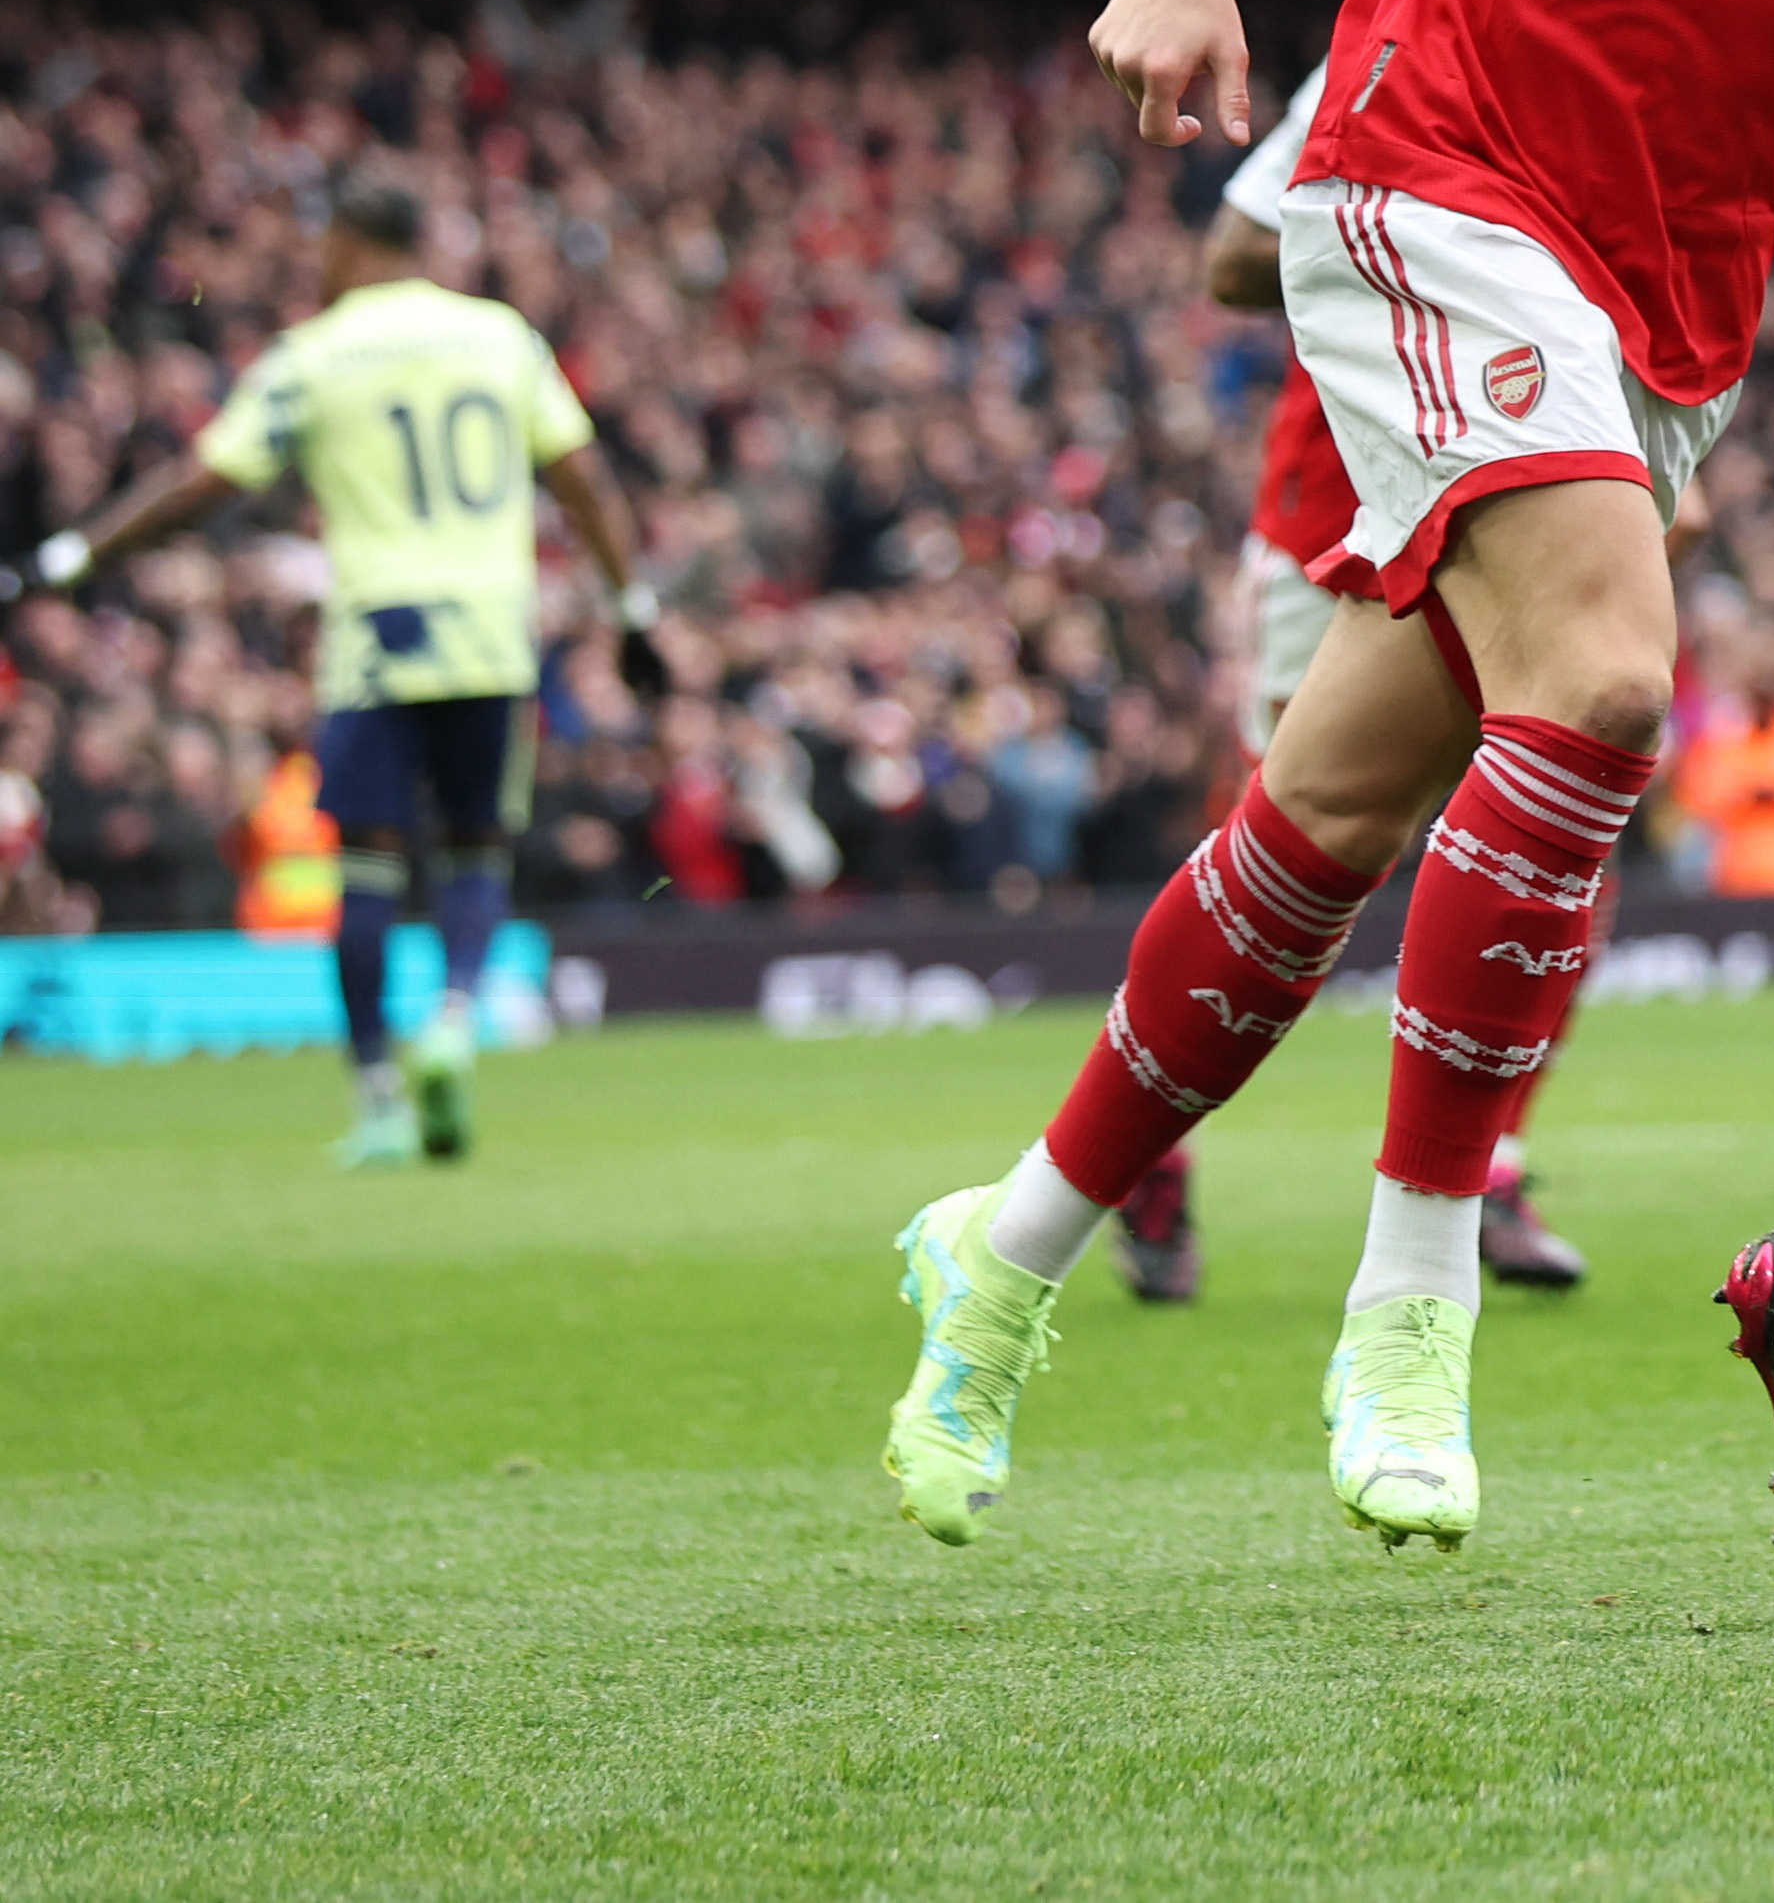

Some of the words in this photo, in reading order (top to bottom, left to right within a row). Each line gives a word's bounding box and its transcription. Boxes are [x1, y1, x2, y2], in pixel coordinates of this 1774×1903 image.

[1490, 354, 1537, 376] Arsenal
[387, 392, 513, 524] 10
[1479, 940, 1586, 976] AFC
